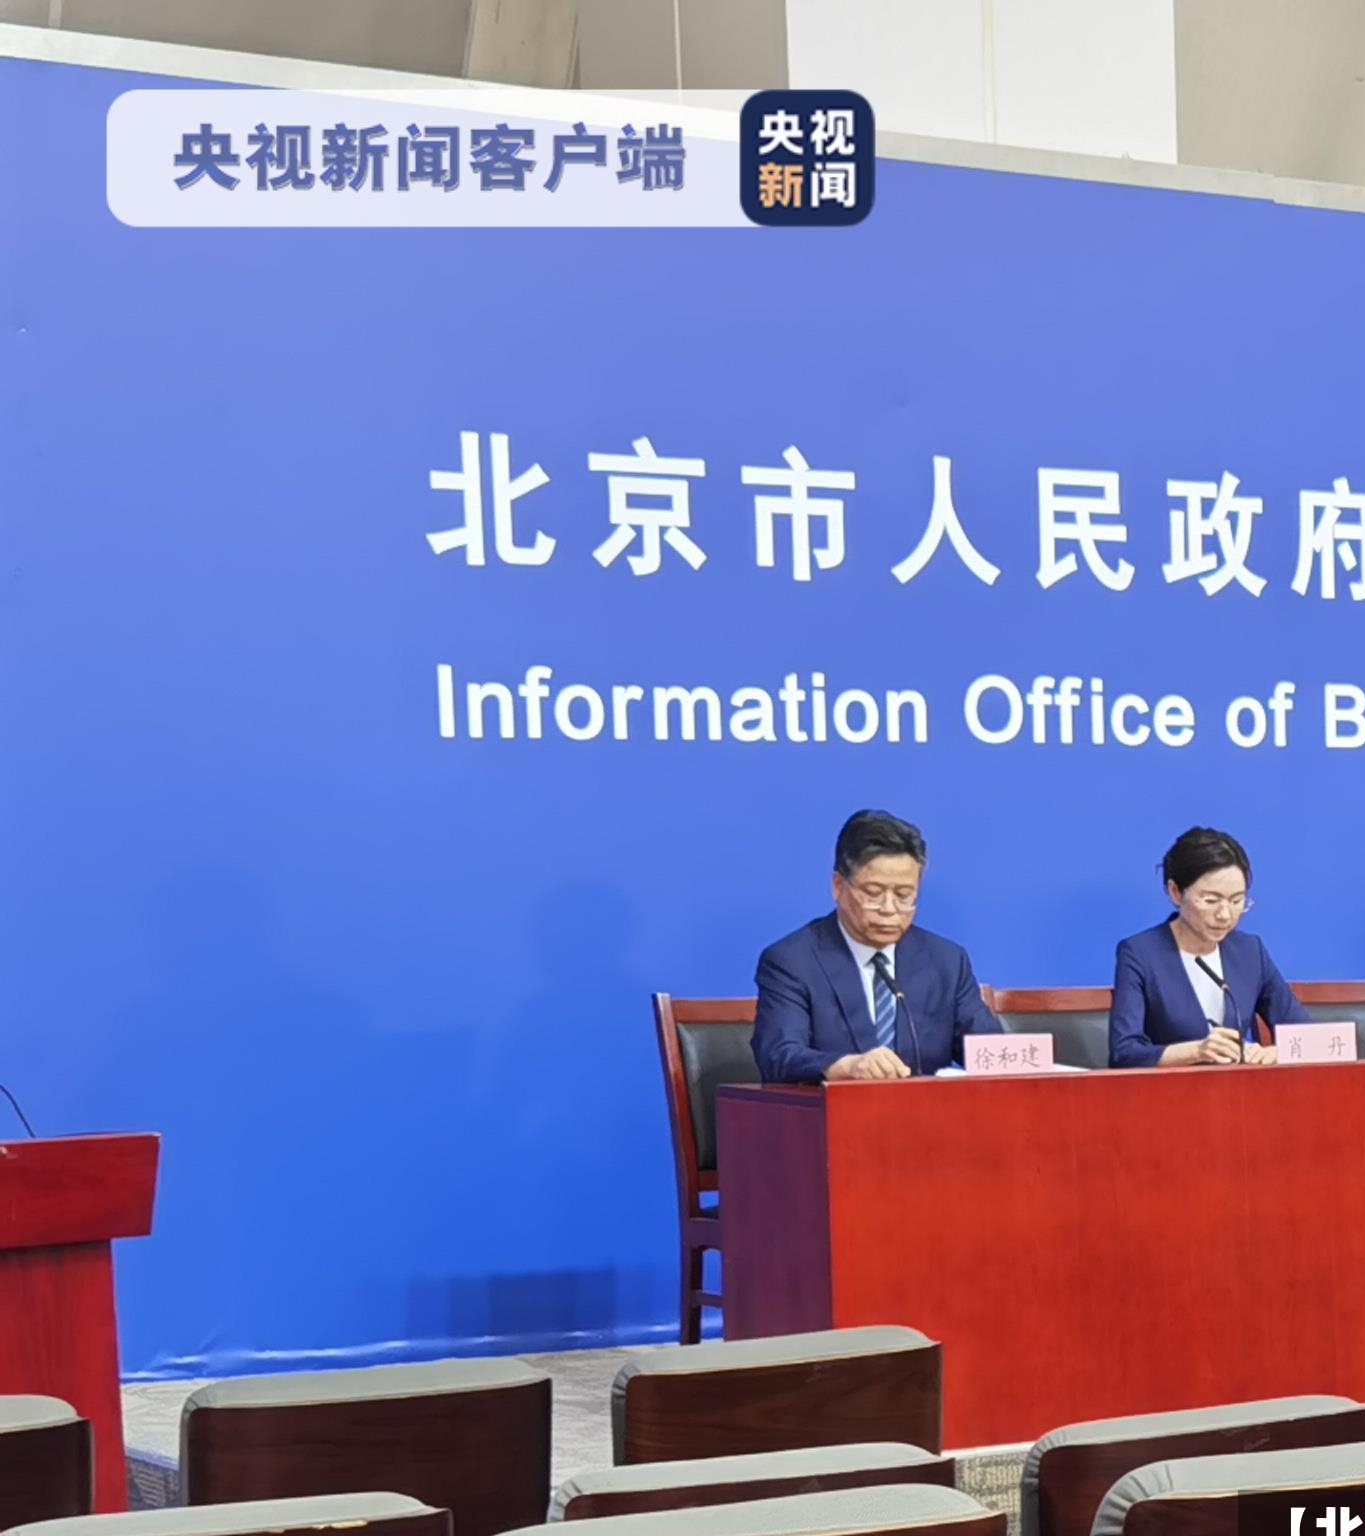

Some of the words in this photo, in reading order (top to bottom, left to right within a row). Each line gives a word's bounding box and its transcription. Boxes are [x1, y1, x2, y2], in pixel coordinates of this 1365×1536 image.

[436, 663, 929, 744] Information
[963, 674, 1196, 748] Office
[1225, 682, 1297, 749] of
[974, 1043, 1041, 1070] 徐和建
